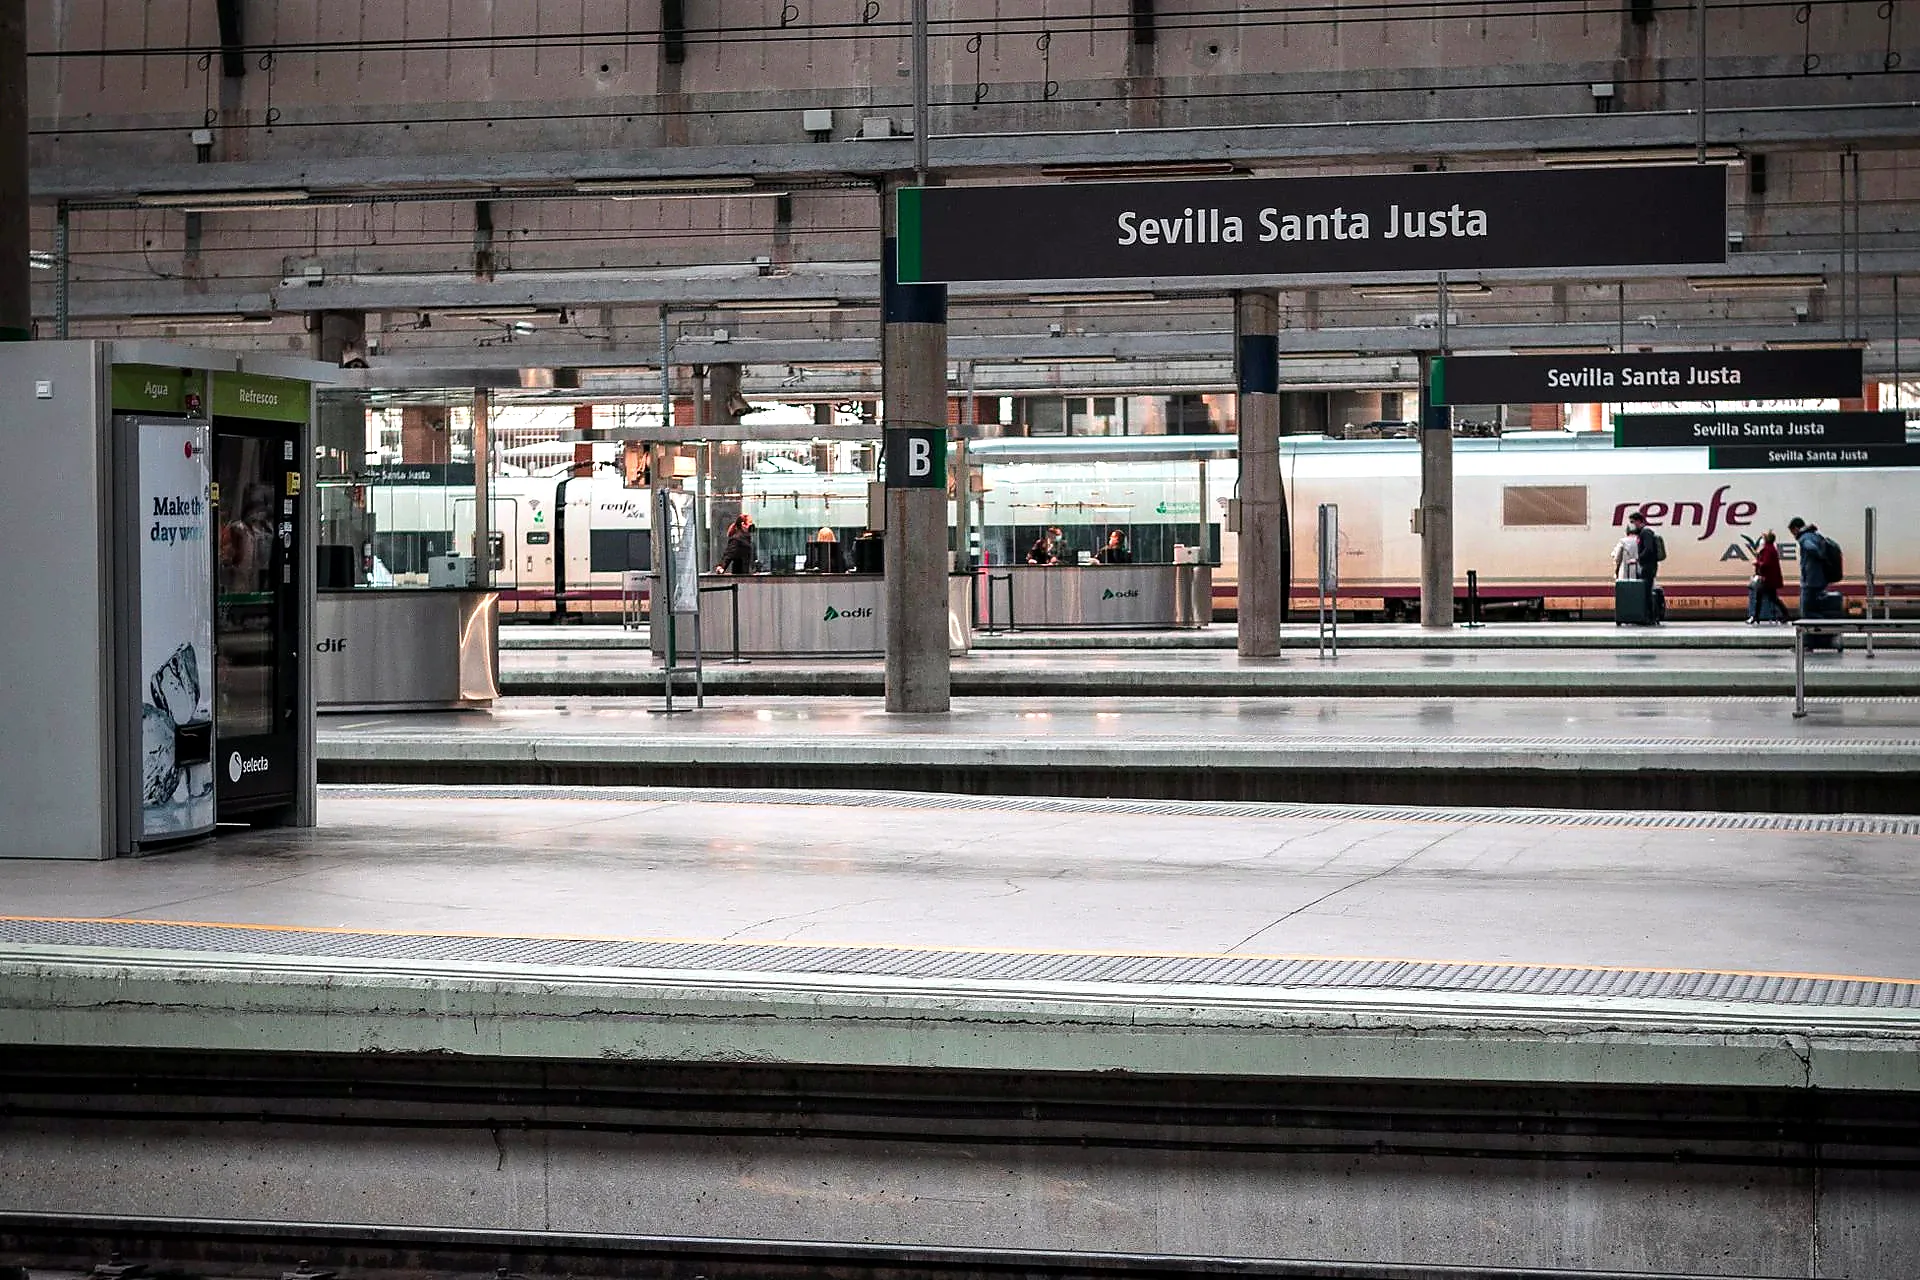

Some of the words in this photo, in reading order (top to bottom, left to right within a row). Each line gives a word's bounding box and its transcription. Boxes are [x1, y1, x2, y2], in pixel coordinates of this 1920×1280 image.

[1118, 208, 1243, 245] Sevilla
[1259, 207, 1369, 242] Santa
[1384, 204, 1487, 239] Justa
[1548, 367, 1614, 387] Sevilla
[1622, 367, 1680, 385] Santa
[1687, 366, 1741, 384] Justa
[144, 381, 168, 398] Agua
[239, 388, 278, 405] Refrescos
[1693, 422, 1739, 436] Sevilla
[1744, 422, 1783, 436] Santa
[1788, 421, 1825, 435] Justa
[909, 438, 930, 476] B
[1768, 450, 1803, 461] Sevilla
[1806, 450, 1837, 461] Santa
[1839, 449, 1868, 460] Justa
[153, 496, 190, 516] Make
[601, 500, 636, 513] renfe
[1612, 485, 1758, 541] renfe
[151, 522, 177, 546] day
[1115, 589, 1138, 598] adif
[841, 607, 873, 618] adif
[316, 638, 347, 652] dif
[243, 756, 269, 772] selecta
